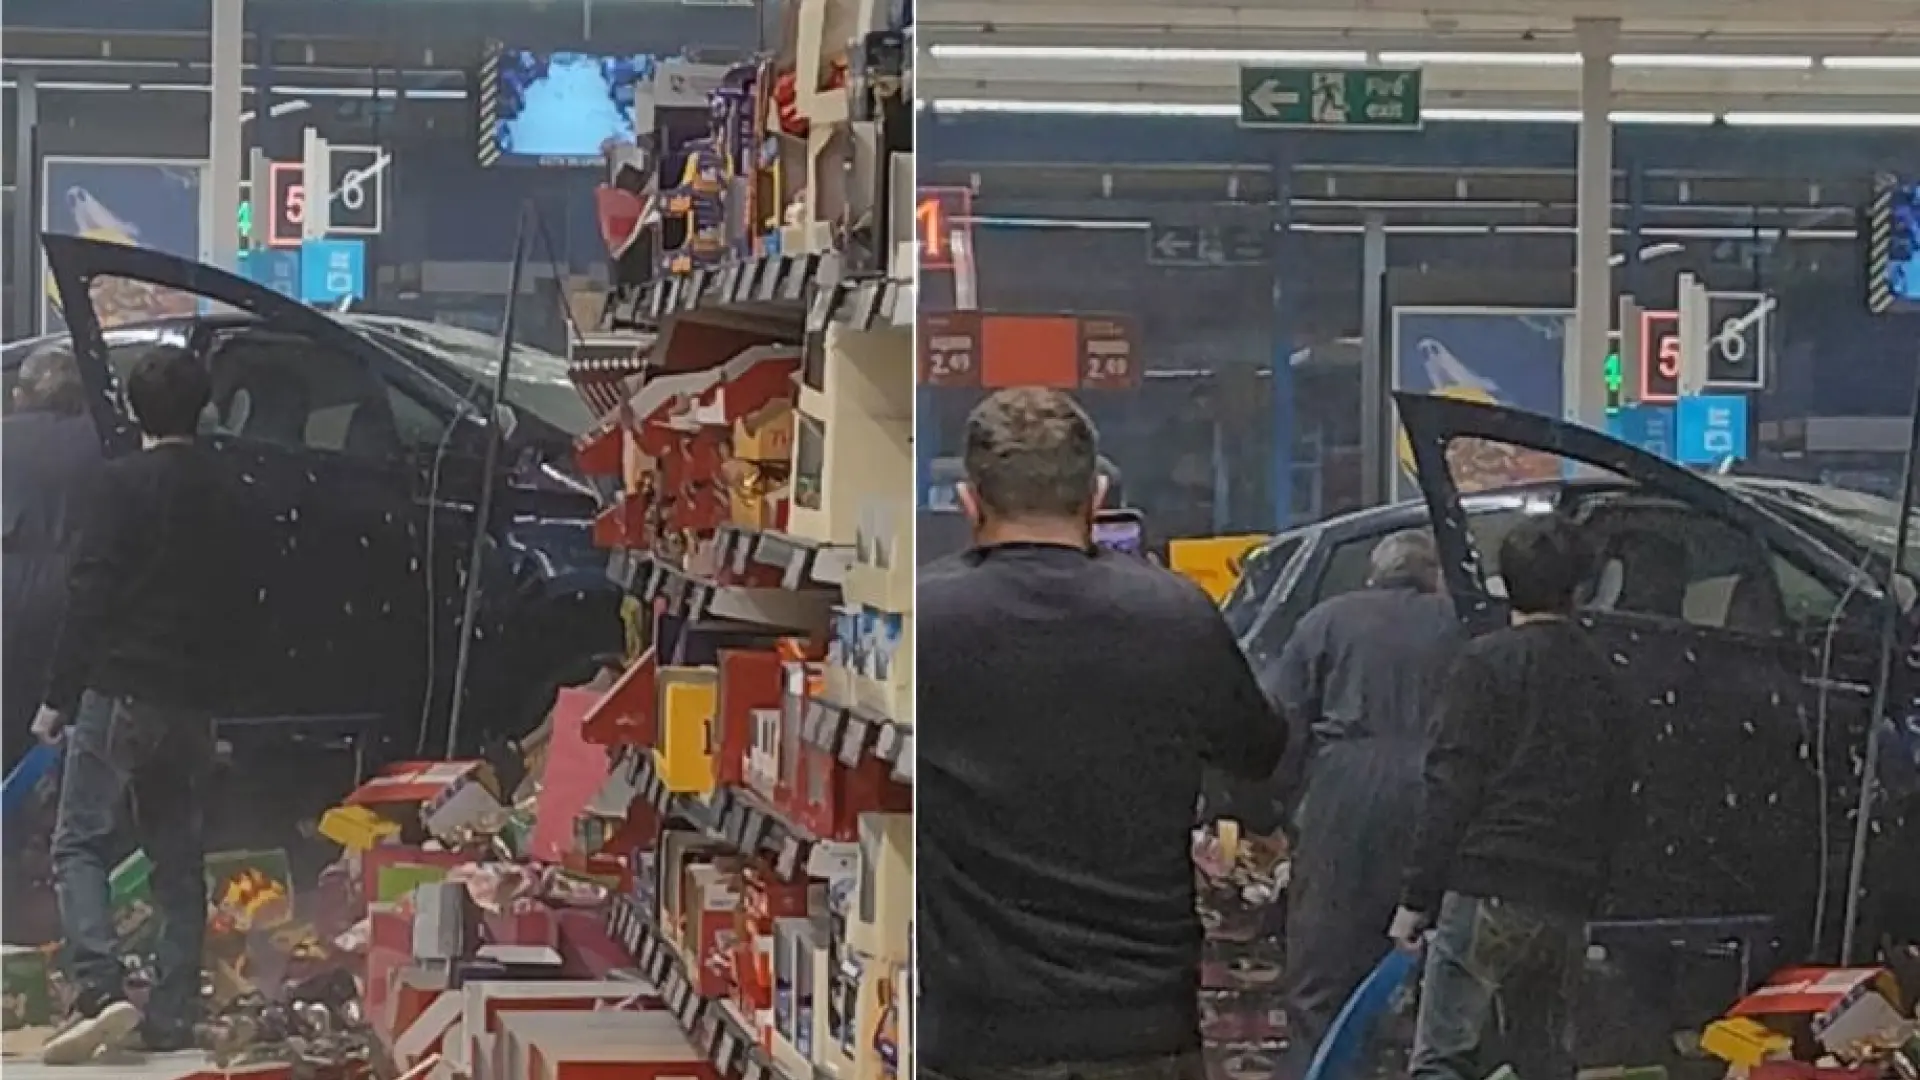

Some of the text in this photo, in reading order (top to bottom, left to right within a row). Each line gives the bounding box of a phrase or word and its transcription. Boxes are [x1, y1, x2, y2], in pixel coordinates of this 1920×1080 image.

[286, 184, 304, 223] 5
[342, 169, 364, 209] 6
[237, 200, 252, 236] 4
[1658, 335, 1680, 378] 5
[1721, 317, 1745, 362] 6
[1603, 353, 1623, 392] 4
